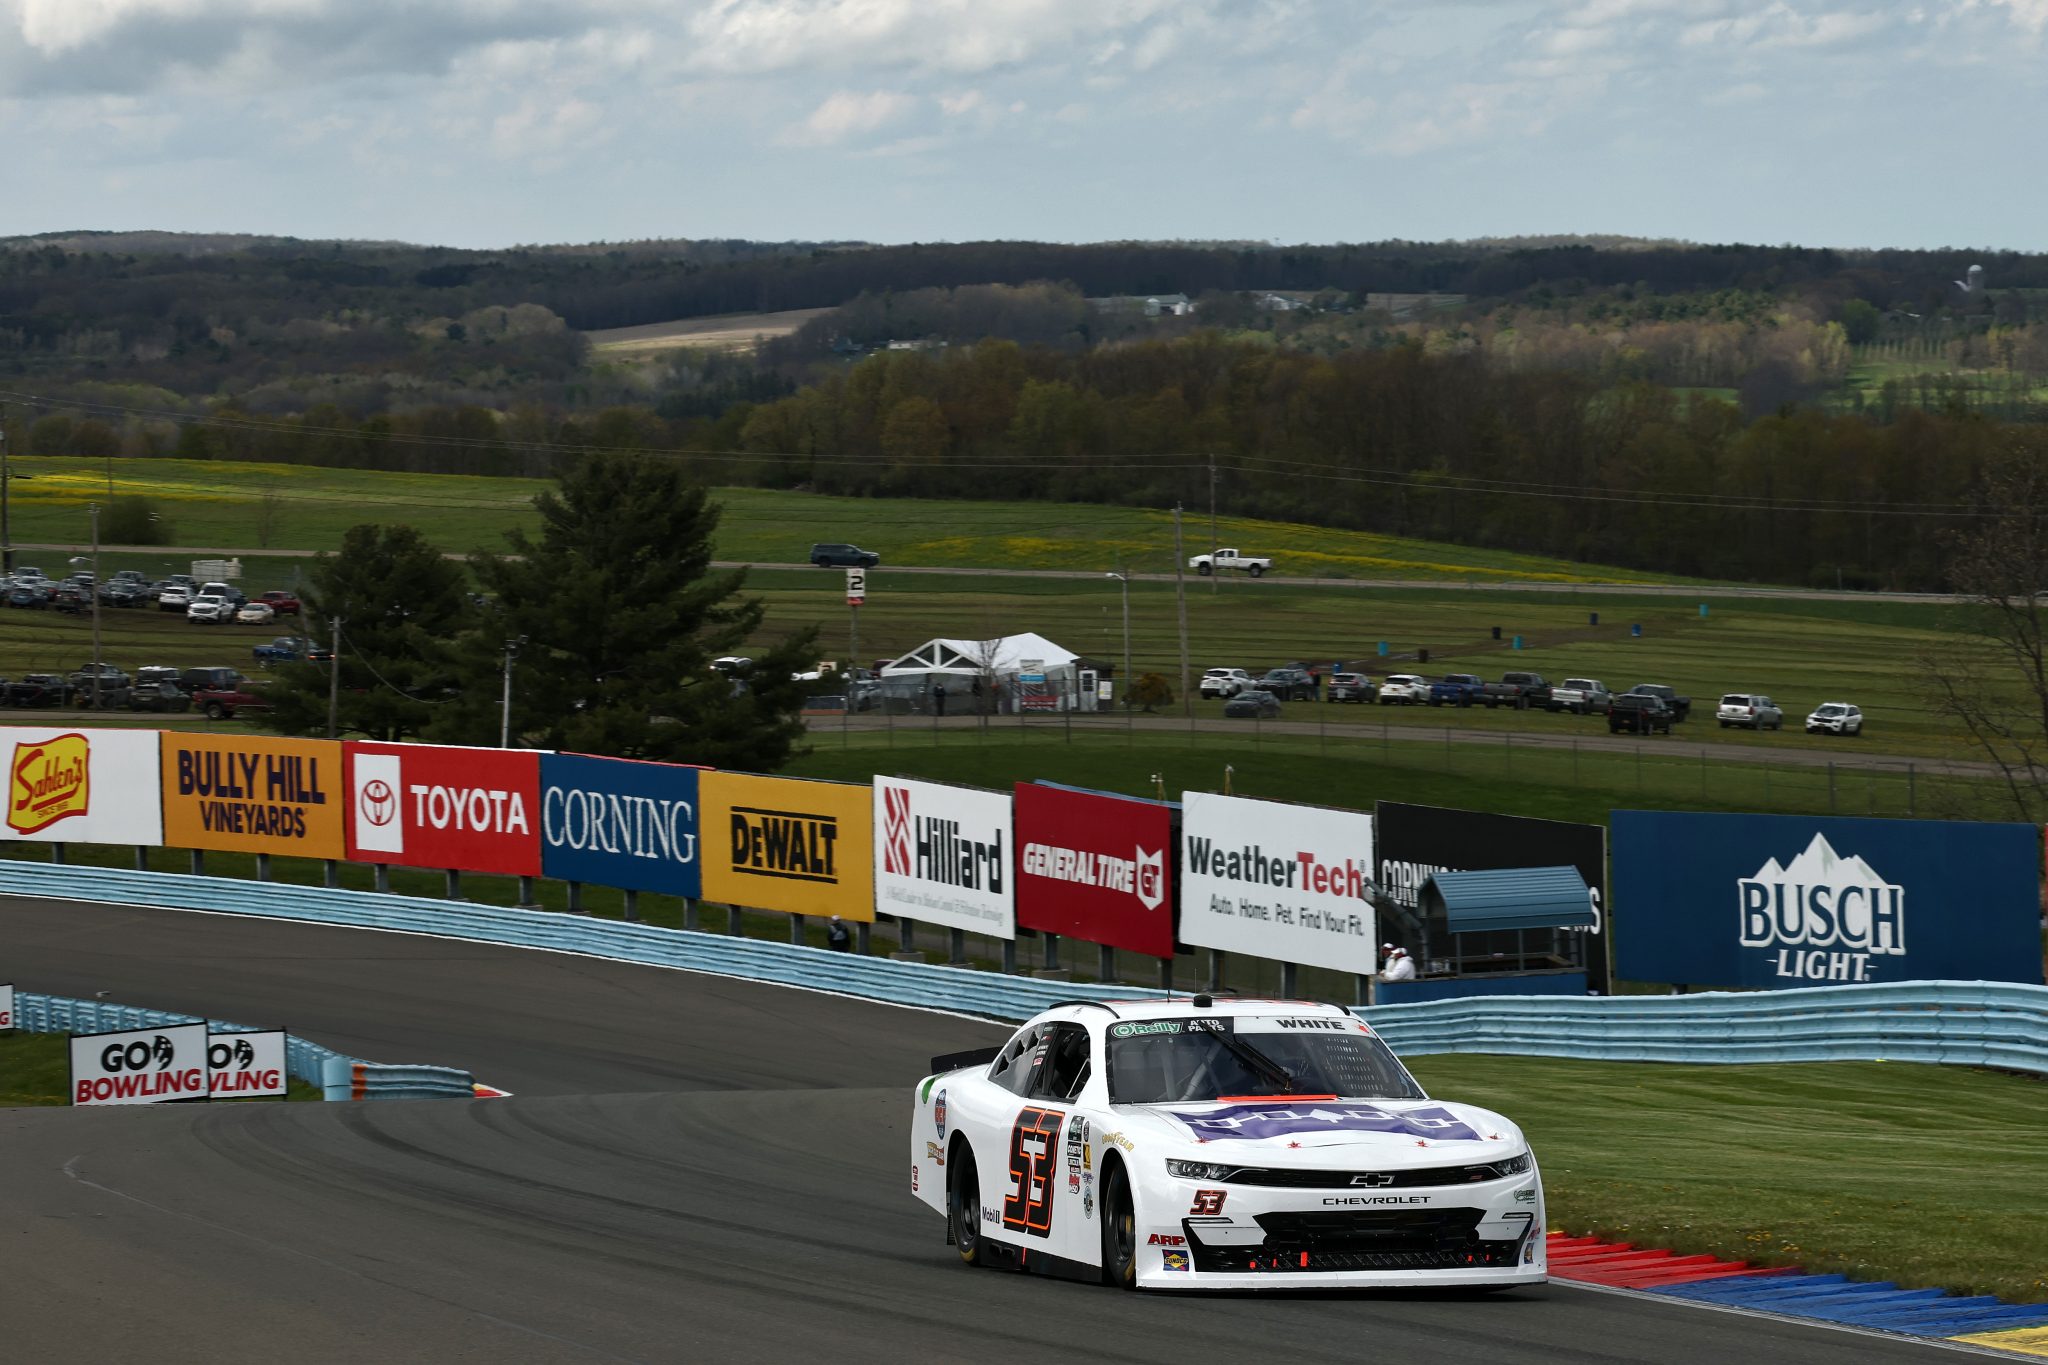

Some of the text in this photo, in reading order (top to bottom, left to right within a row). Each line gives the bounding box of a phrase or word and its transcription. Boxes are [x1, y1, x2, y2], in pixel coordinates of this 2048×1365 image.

[851, 575, 864, 590] 2
[16, 749, 82, 811] Sahlen's
[178, 749, 327, 804] BULLY HILL
[200, 801, 306, 838] VINEYARDS
[410, 784, 530, 835] TOYOTA
[543, 786, 696, 863] CORNING
[915, 815, 1003, 894] Hilliard
[1023, 842, 1137, 894] GENERAL TIRE
[1188, 835, 1362, 899] WeatherTech
[1209, 893, 1365, 936] Auto. Home. Pet. Find Your Fit.
[1739, 879, 1905, 954] BUSCH
[1776, 950, 1870, 981] LIGHT
[1113, 1022, 1182, 1038] O'Reilly
[1276, 1019, 1346, 1030] WHITE
[101, 1041, 150, 1072] GO
[76, 1068, 201, 1103] BOWLING
[1102, 1132, 1134, 1152] GOODYEAR
[1003, 1105, 1066, 1239] 53
[1190, 1189, 1227, 1215] 53
[1322, 1197, 1431, 1205] CHEVROLET
[1147, 1234, 1186, 1245] ARP
